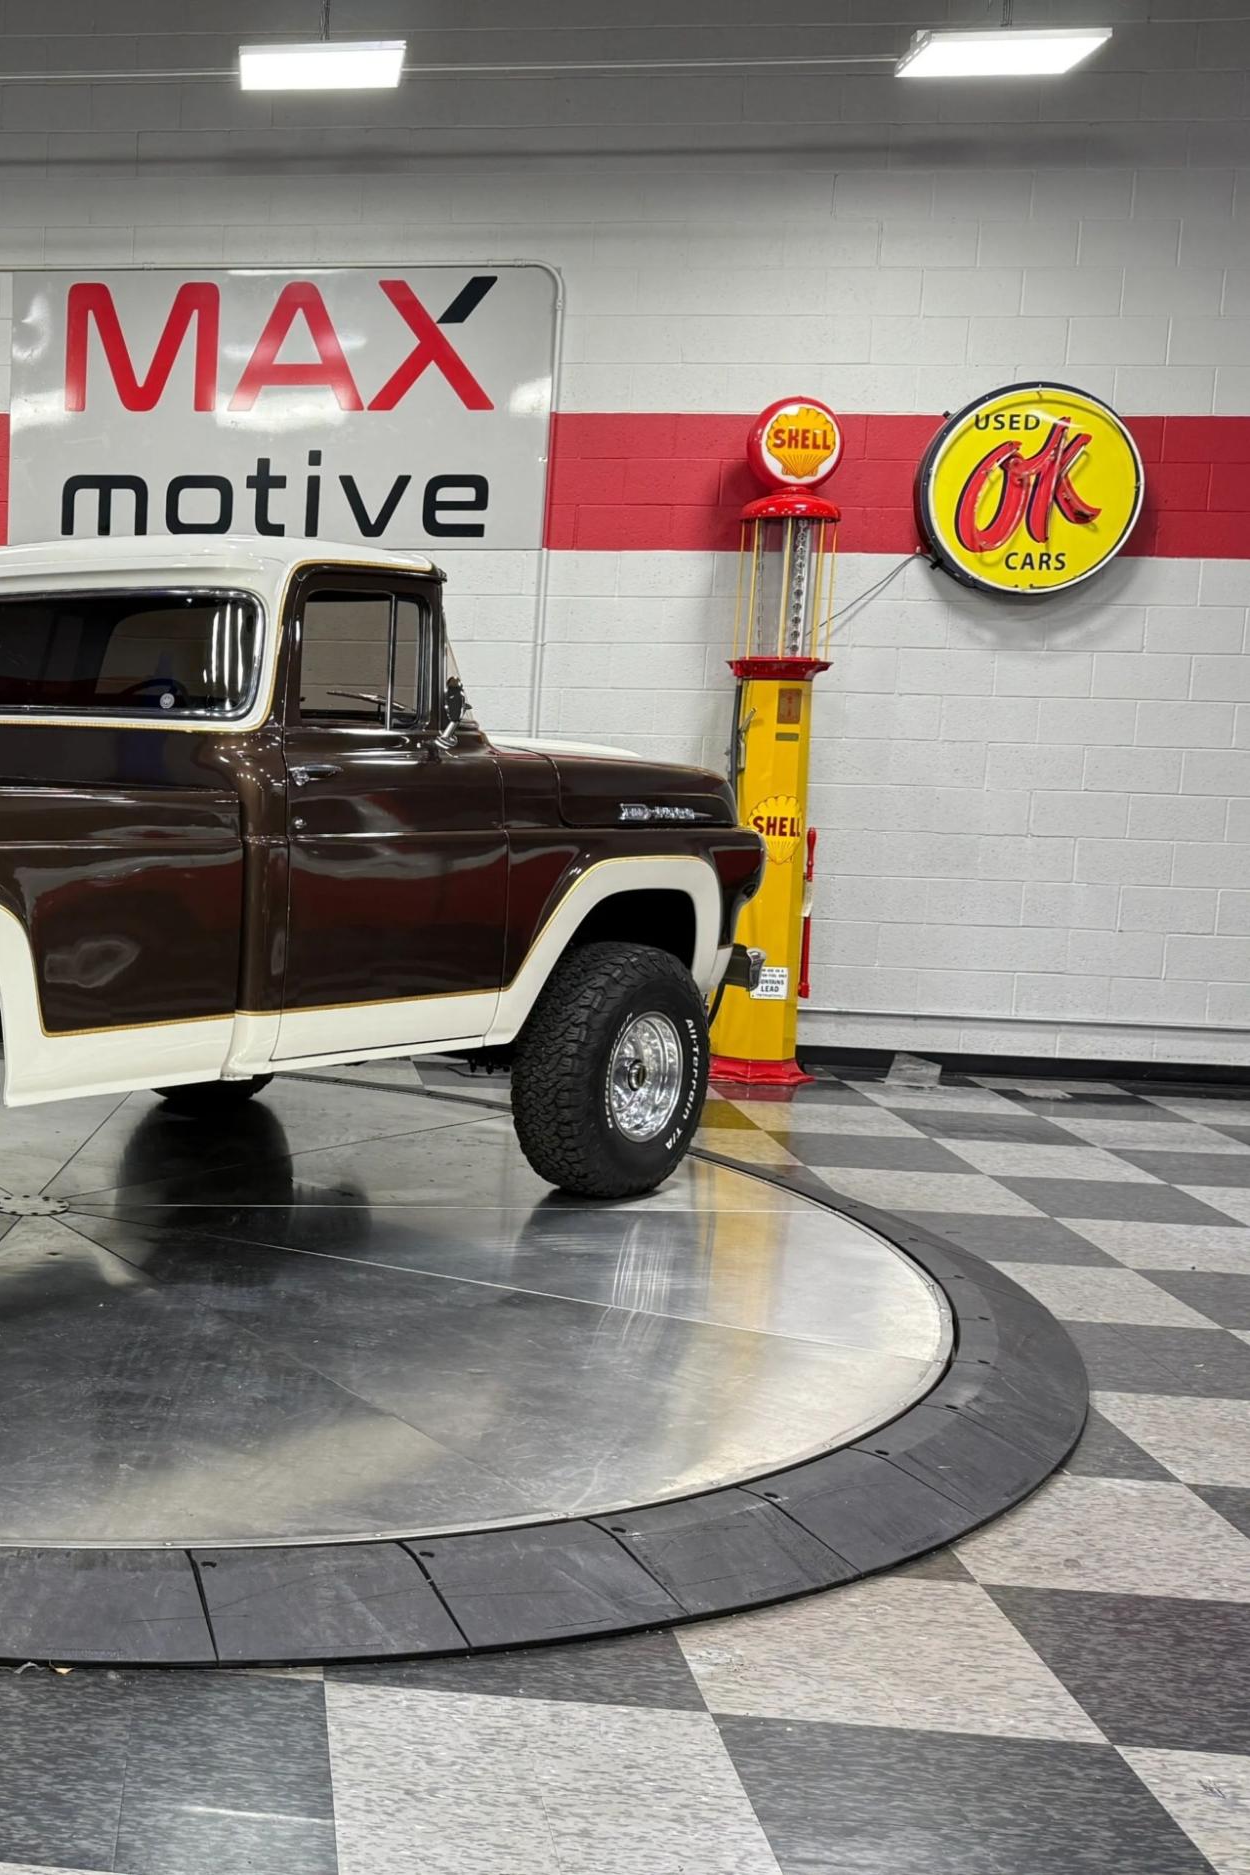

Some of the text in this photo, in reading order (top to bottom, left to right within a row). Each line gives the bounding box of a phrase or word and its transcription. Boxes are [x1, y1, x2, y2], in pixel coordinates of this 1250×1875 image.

[64, 275, 498, 412] MAX
[974, 414, 1040, 430] USED
[772, 428, 831, 450] SHELL
[61, 450, 490, 538] motive
[954, 416, 1102, 553] OK
[1005, 552, 1066, 570] CARS
[752, 815, 800, 838] SHELL
